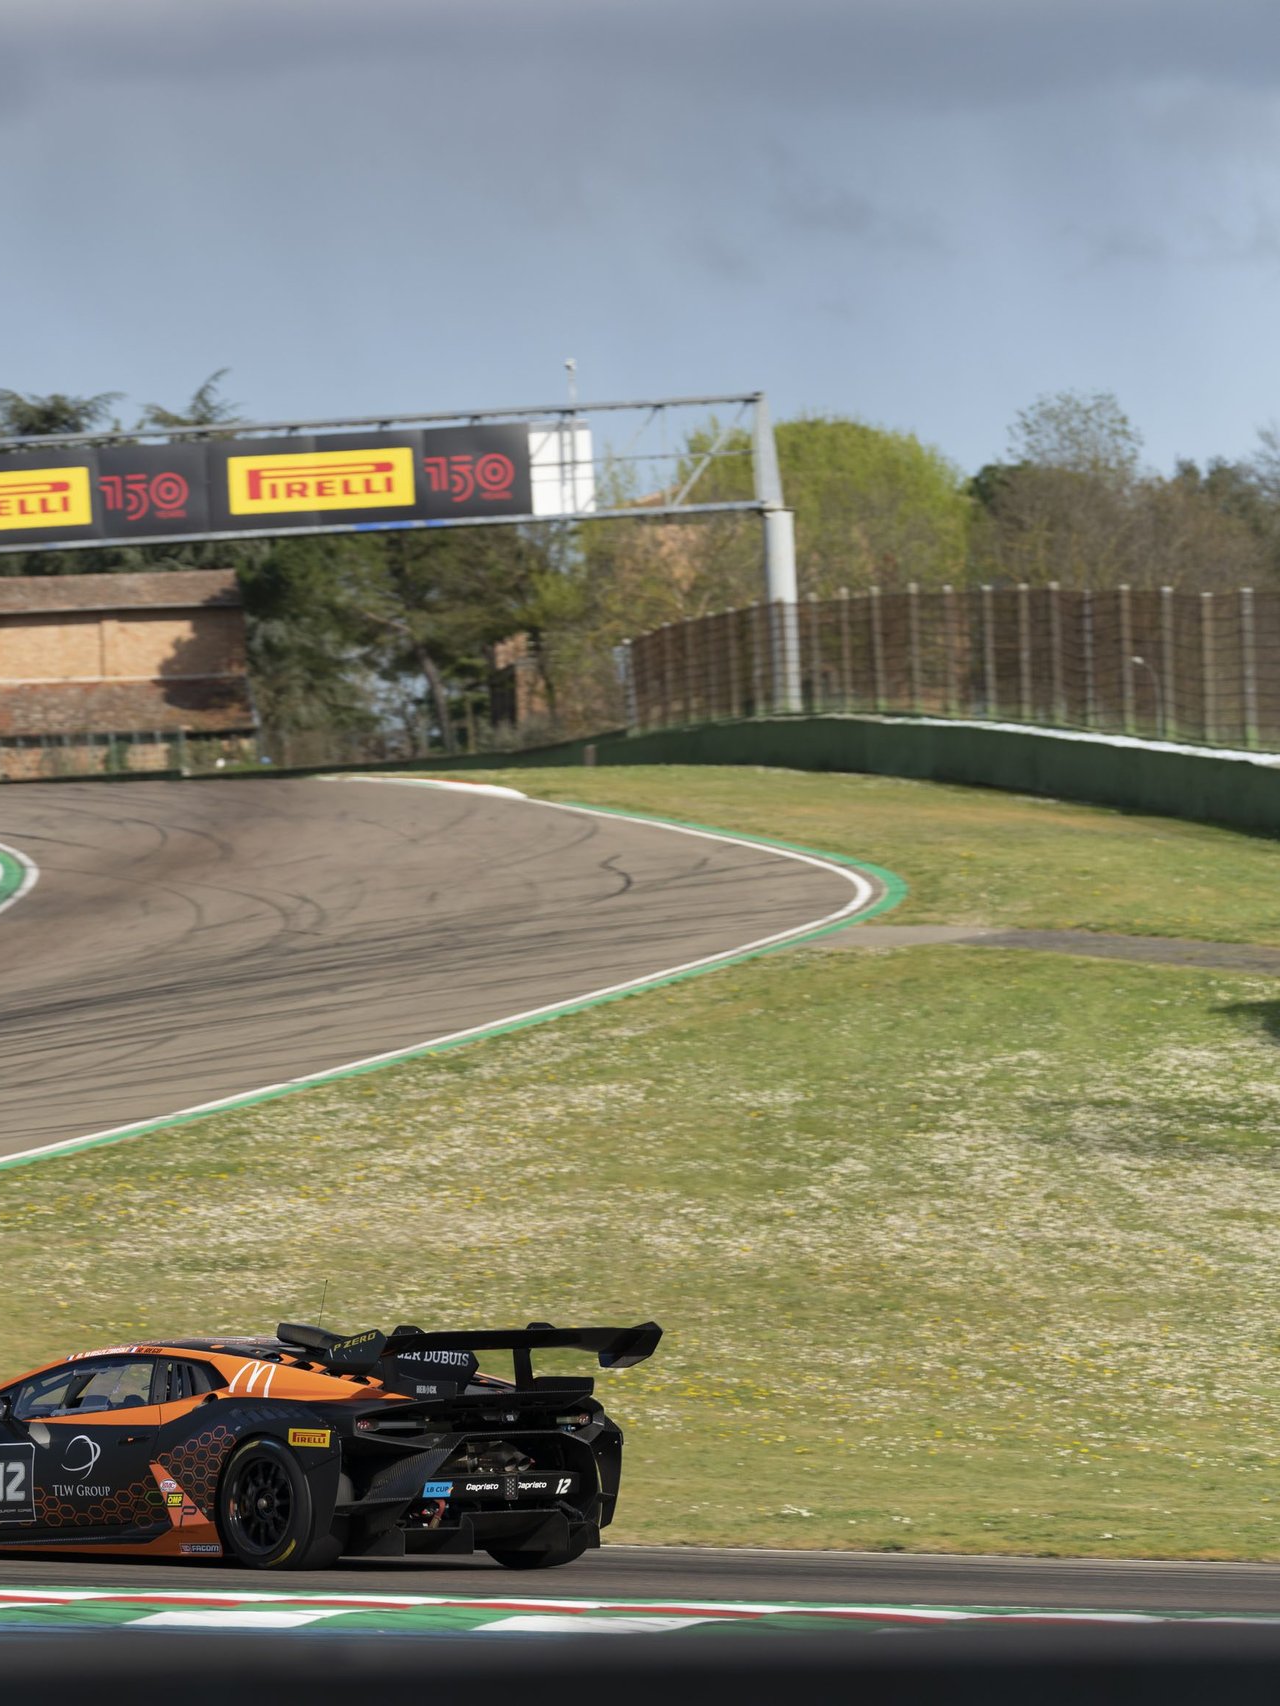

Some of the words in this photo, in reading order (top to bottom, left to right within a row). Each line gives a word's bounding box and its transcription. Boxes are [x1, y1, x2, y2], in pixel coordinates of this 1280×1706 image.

[247, 462, 395, 501] PIRELLI
[423, 452, 515, 503] 150
[99, 471, 189, 521] 150
[333, 1343, 341, 1352] P
[343, 1332, 377, 1349] ZERO
[423, 1350, 470, 1367] DUBUIS
[292, 1431, 327, 1444] PIRELLI
[52, 1484, 74, 1497] TLW
[465, 1483, 499, 1492] Capristo
[555, 1478, 572, 1495] 12
[167, 1496, 183, 1504] OMP
[191, 1545, 220, 1553] FACOM
